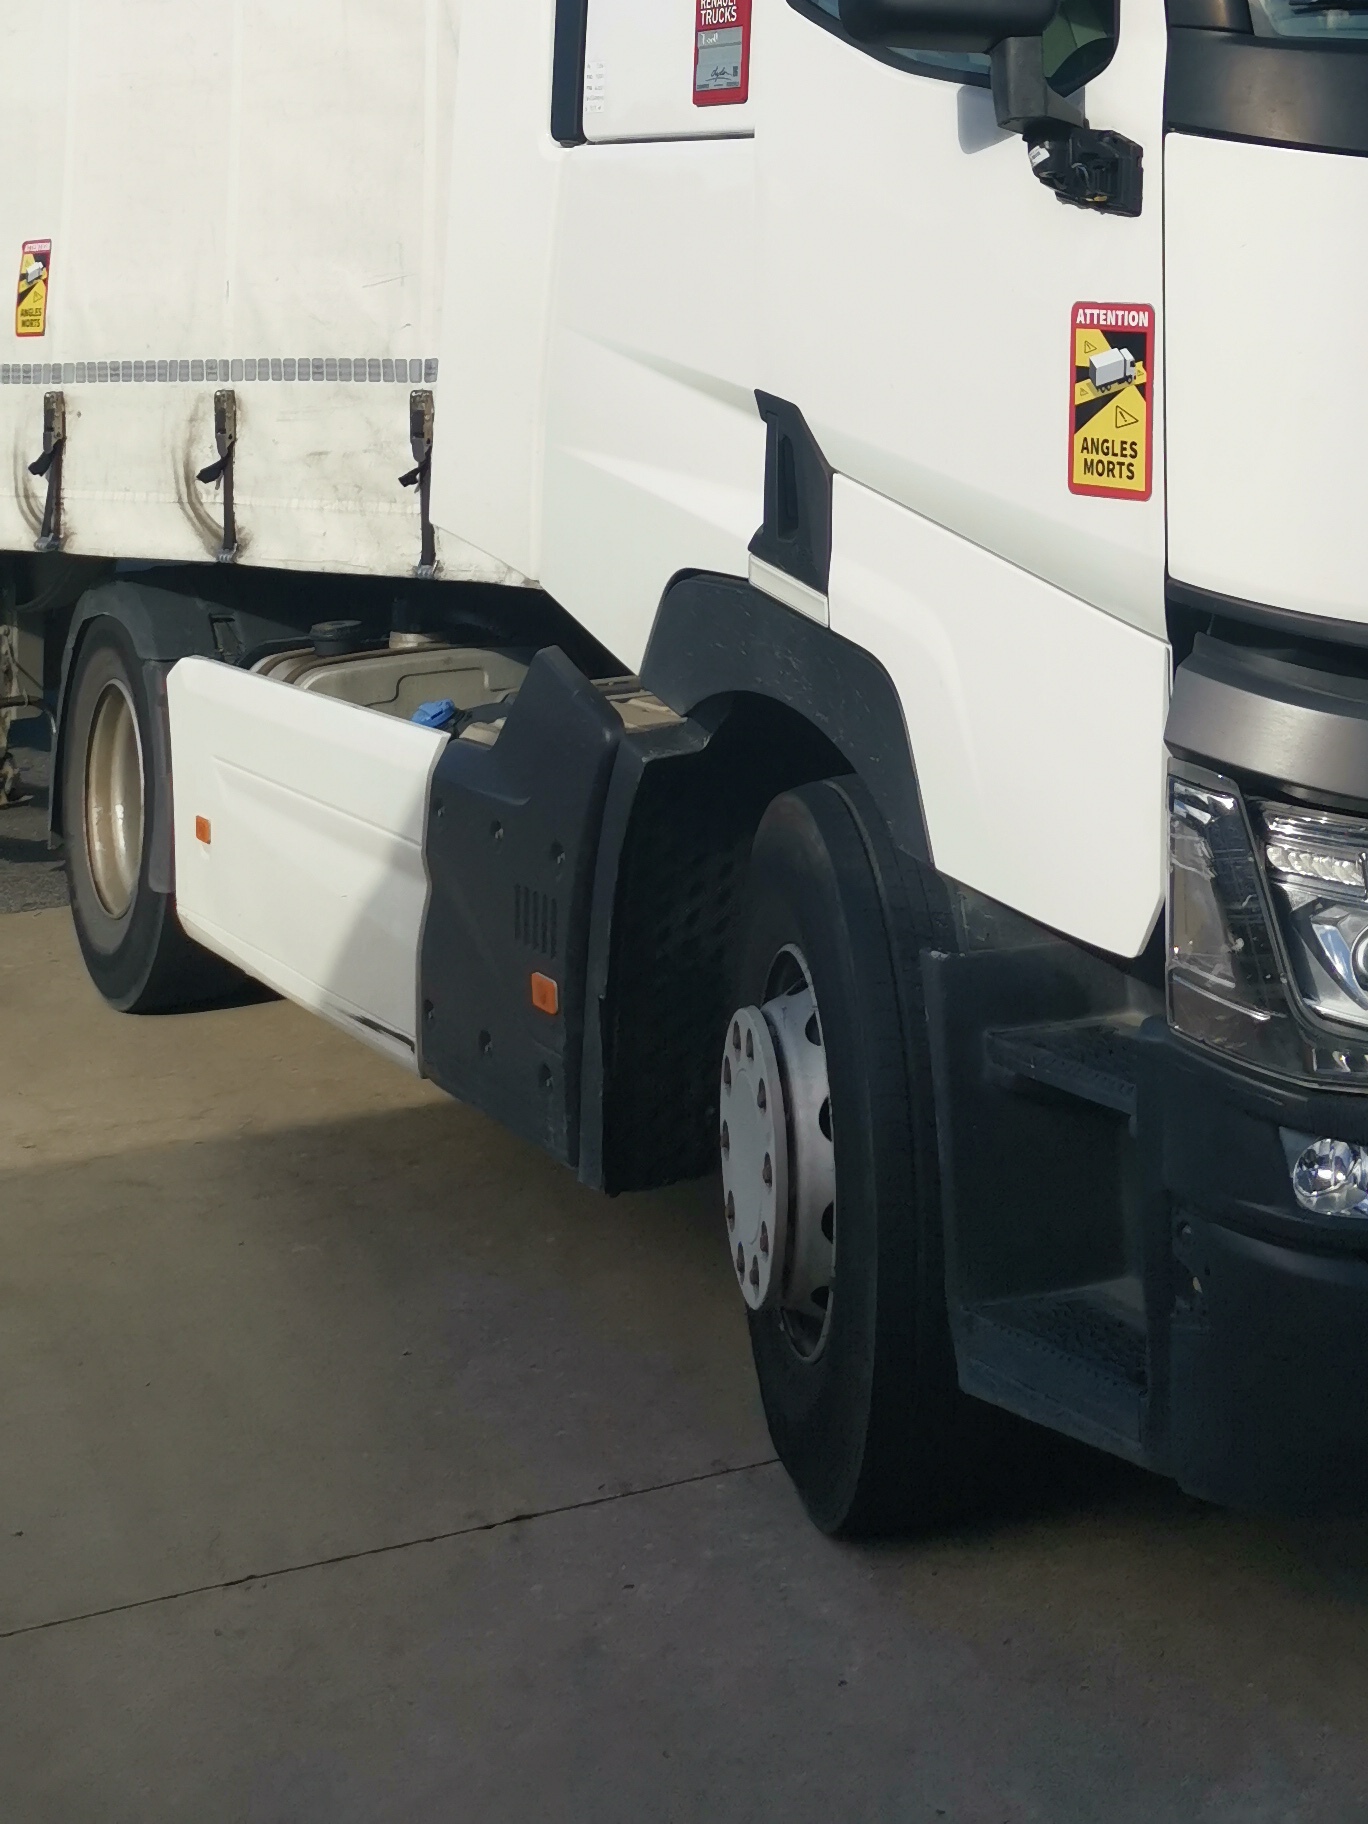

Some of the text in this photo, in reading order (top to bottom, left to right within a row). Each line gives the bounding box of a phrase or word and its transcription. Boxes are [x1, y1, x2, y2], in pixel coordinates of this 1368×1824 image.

[700, 6, 738, 26] TRUCKS
[1076, 308, 1149, 328] ATTENTION
[1080, 436, 1138, 459] ANGLES
[1083, 457, 1135, 481] MORTS
